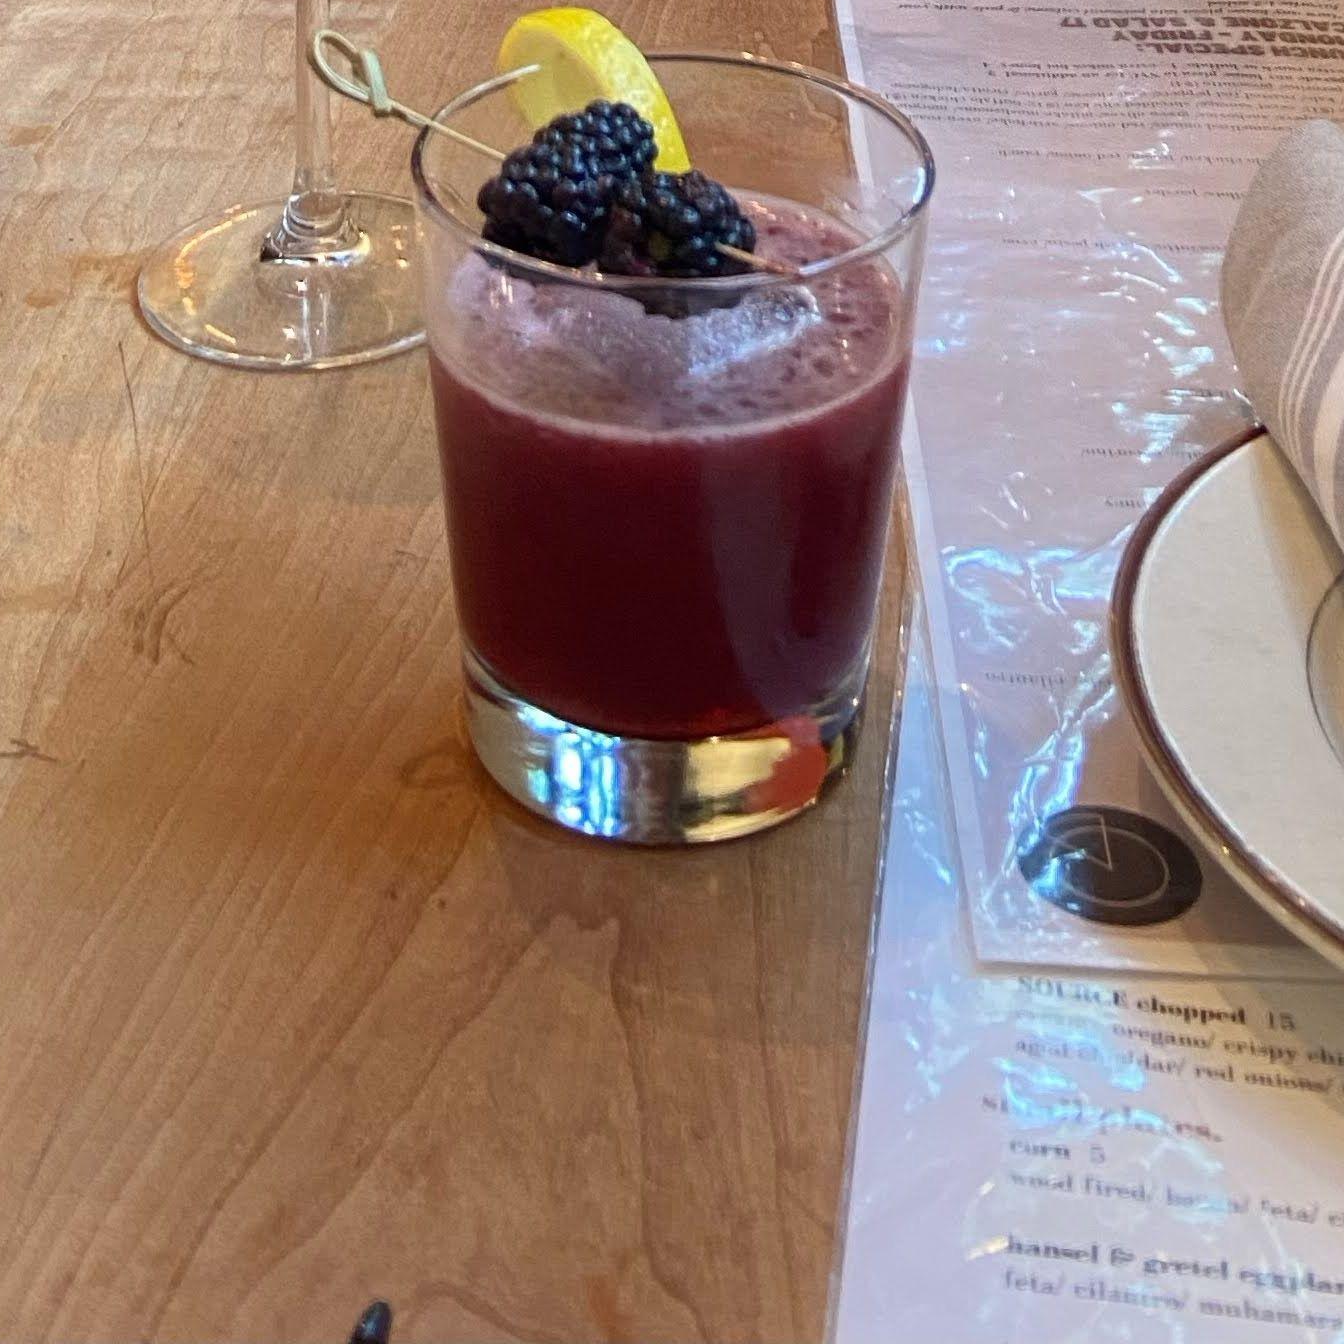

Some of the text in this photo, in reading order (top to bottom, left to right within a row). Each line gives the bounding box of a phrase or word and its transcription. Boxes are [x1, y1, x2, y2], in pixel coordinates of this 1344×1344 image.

[1092, 15, 1188, 29] SALAD
[1112, 29, 1213, 43] FRIDAY
[1135, 42, 1266, 58] SPECIAL:
[1136, 993, 1248, 1027] chopped
[1265, 1010, 1297, 1033] 15
[1222, 1038, 1298, 1066] crispy
[1194, 1063, 1235, 1086] red
[1009, 1139, 1106, 1165] corn 5
[1009, 1170, 1074, 1194] wood
[1008, 1235, 1099, 1265] hansel
[1142, 1255, 1229, 1282] gretel
[1004, 1270, 1067, 1297] feta/
